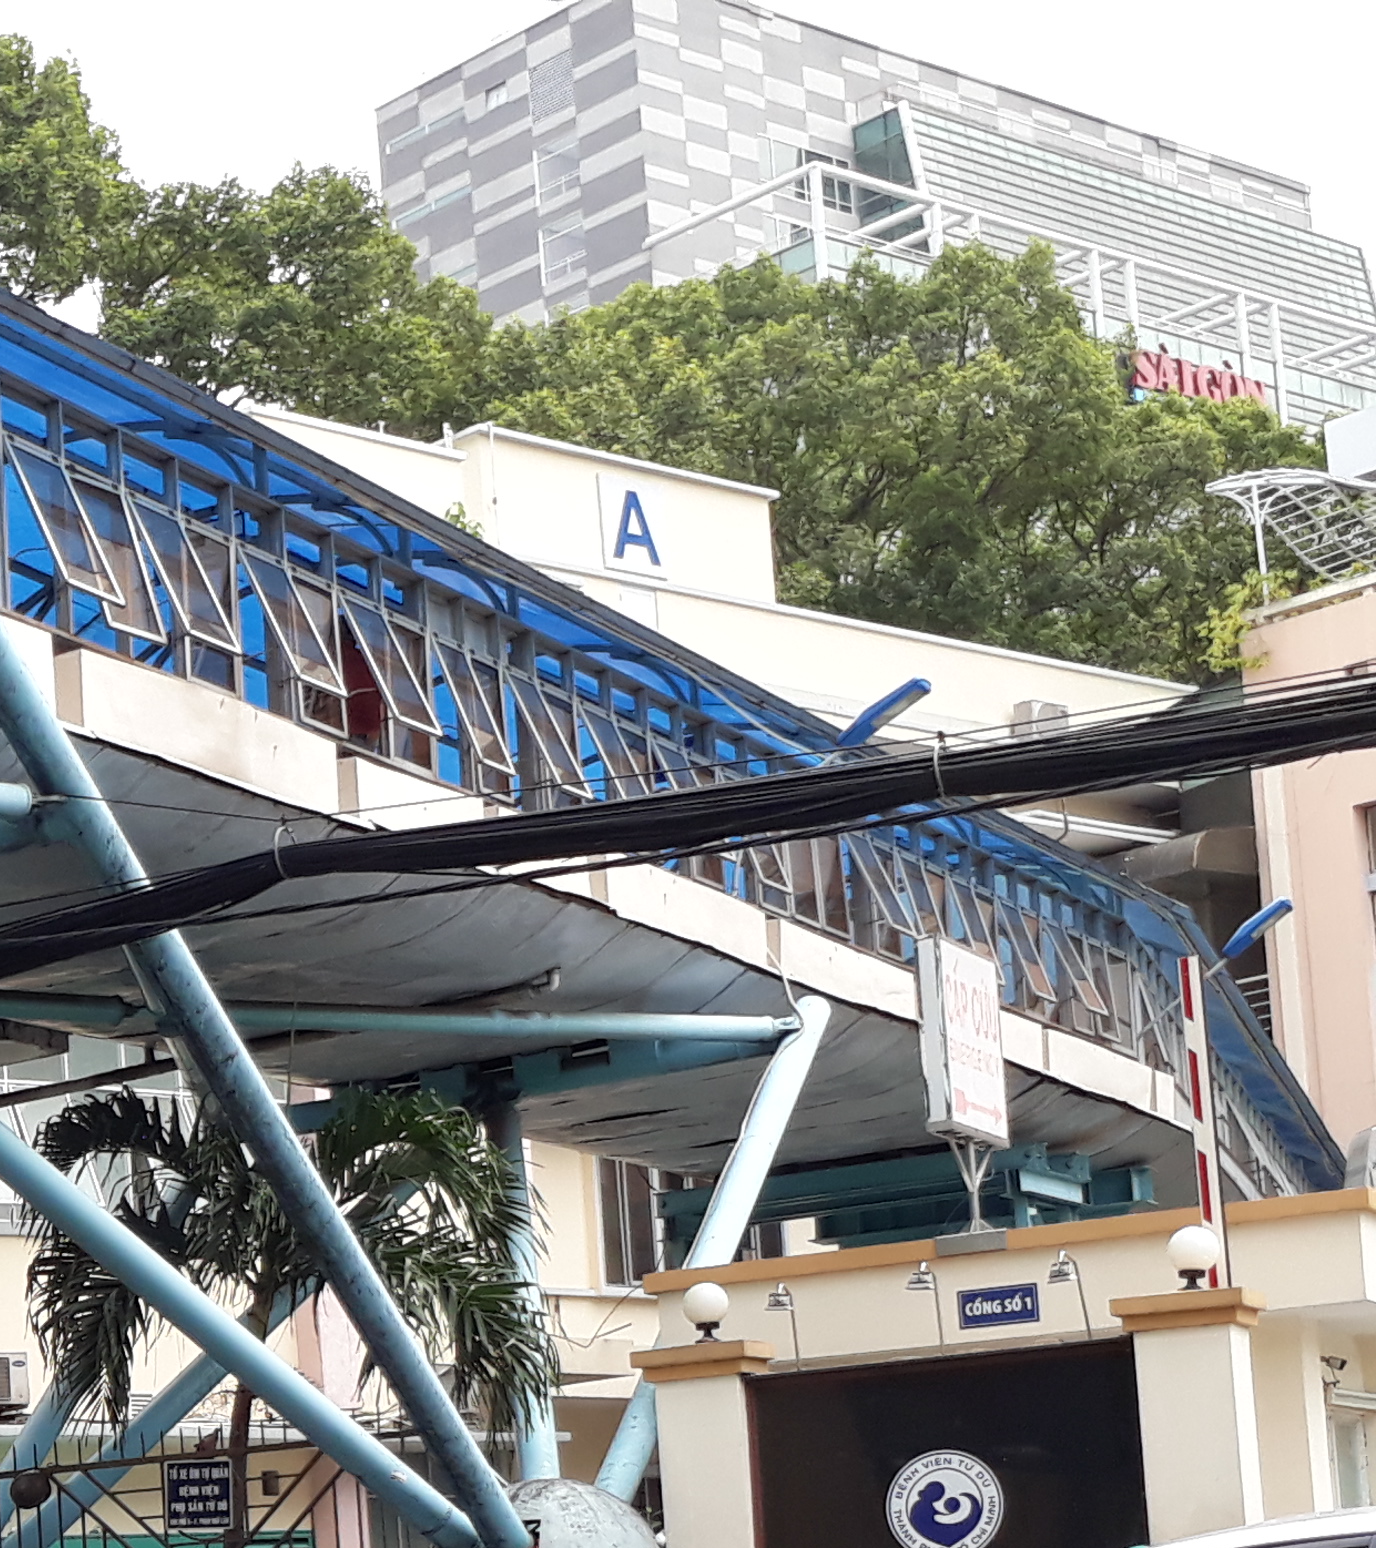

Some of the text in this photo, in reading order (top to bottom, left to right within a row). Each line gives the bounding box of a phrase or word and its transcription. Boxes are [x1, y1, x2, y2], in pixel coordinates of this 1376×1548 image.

[612, 489, 662, 567] A
[1003, 1292, 1023, 1313] SỐ
[1024, 1296, 1033, 1311] 1
